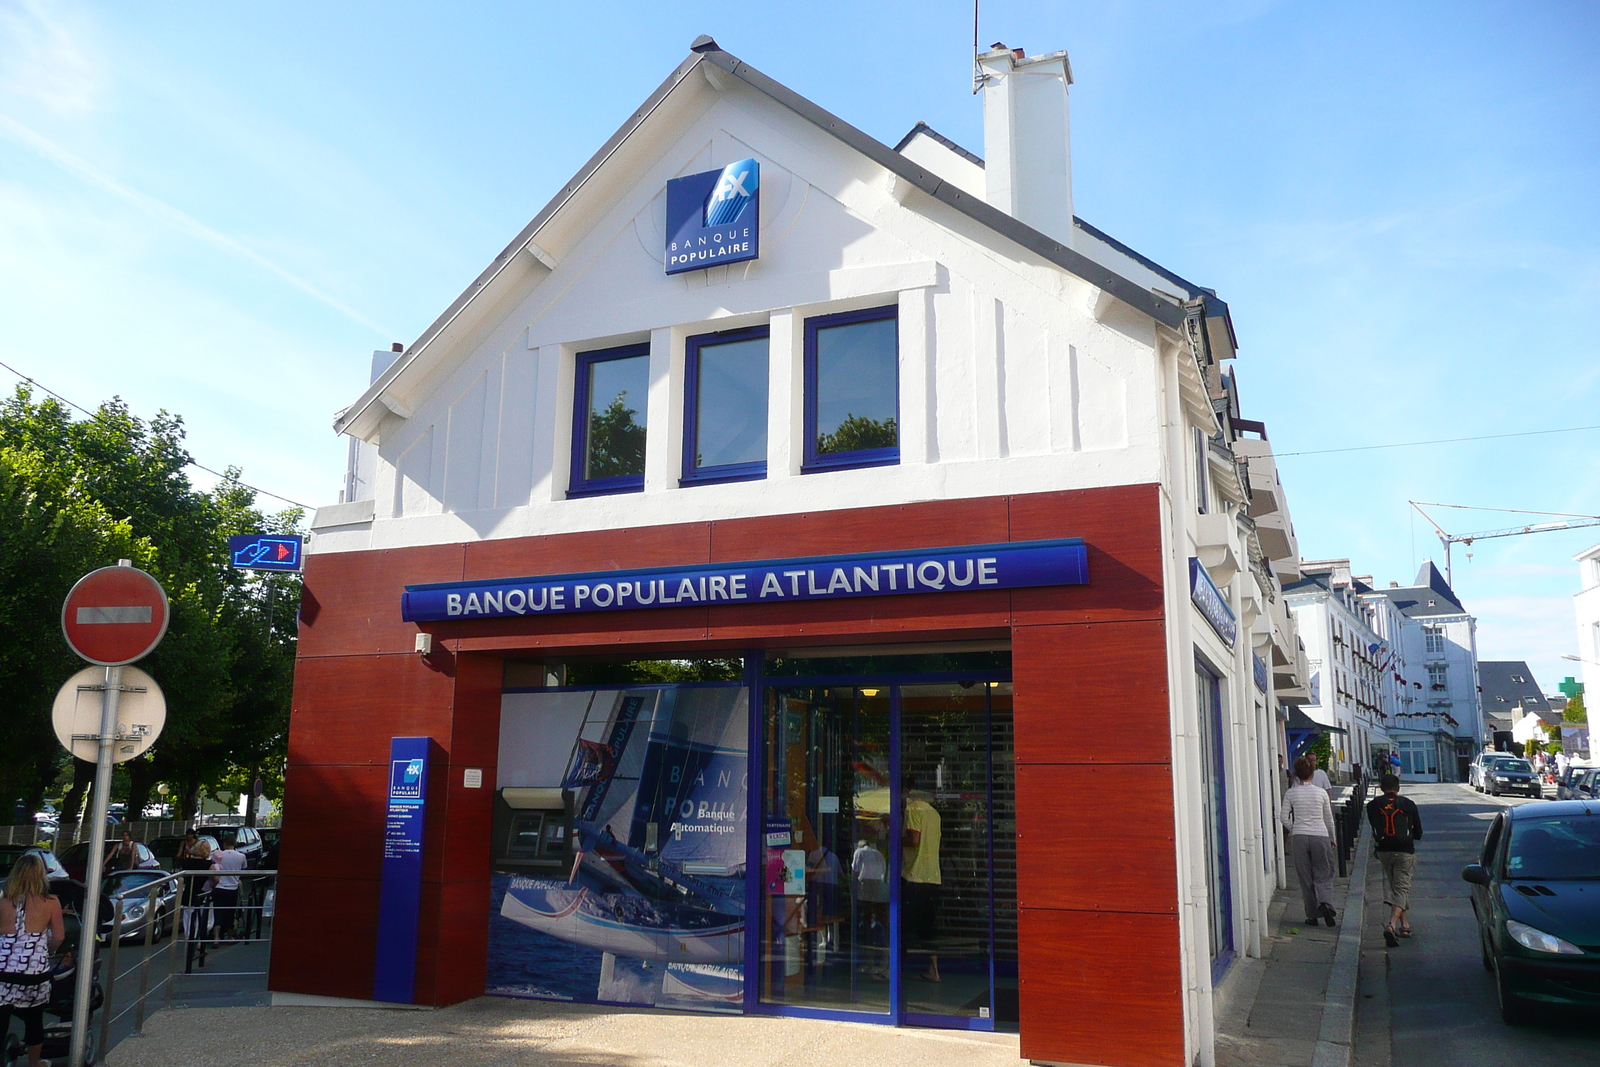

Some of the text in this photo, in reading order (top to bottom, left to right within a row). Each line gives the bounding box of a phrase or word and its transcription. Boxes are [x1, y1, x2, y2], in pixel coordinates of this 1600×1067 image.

[671, 228, 749, 252] BANQUE
[671, 242, 749, 265] POPULAIRE
[446, 557, 998, 615] BANQUE POPULAIRE ATLANTIQUE
[698, 808, 735, 821] Banque
